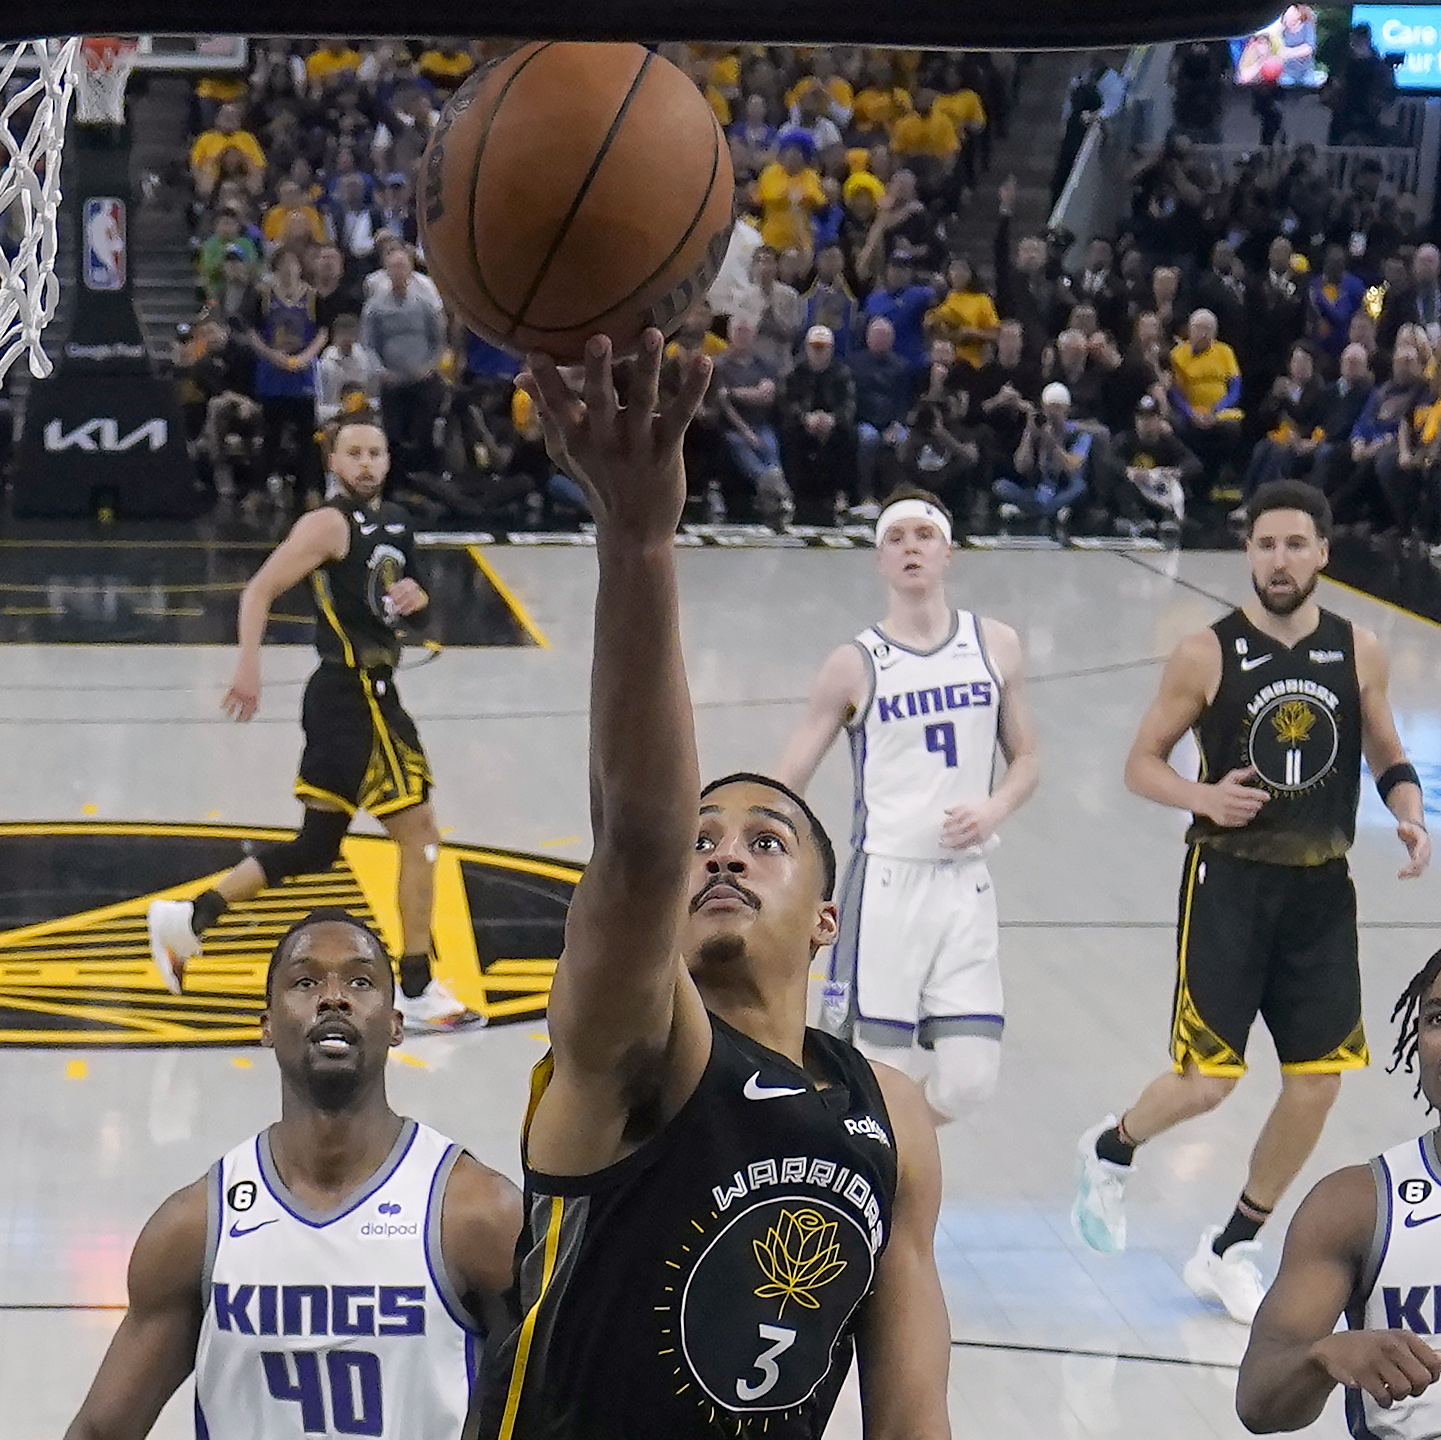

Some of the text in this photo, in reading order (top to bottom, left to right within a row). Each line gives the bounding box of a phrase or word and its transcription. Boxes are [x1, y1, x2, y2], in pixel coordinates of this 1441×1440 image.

[1382, 19, 1438, 46] Care
[877, 681, 992, 723] KINGS
[924, 721, 958, 768] 9
[1285, 748, 1302, 785] 11
[231, 1183, 255, 1209] 6
[712, 1156, 883, 1256] WARRIORS
[1403, 1181, 1427, 1203] 6
[360, 1222, 418, 1237] dialpad
[212, 1282, 427, 1337] KINGS
[736, 1323, 797, 1401] 3
[261, 1350, 383, 1437] 40
